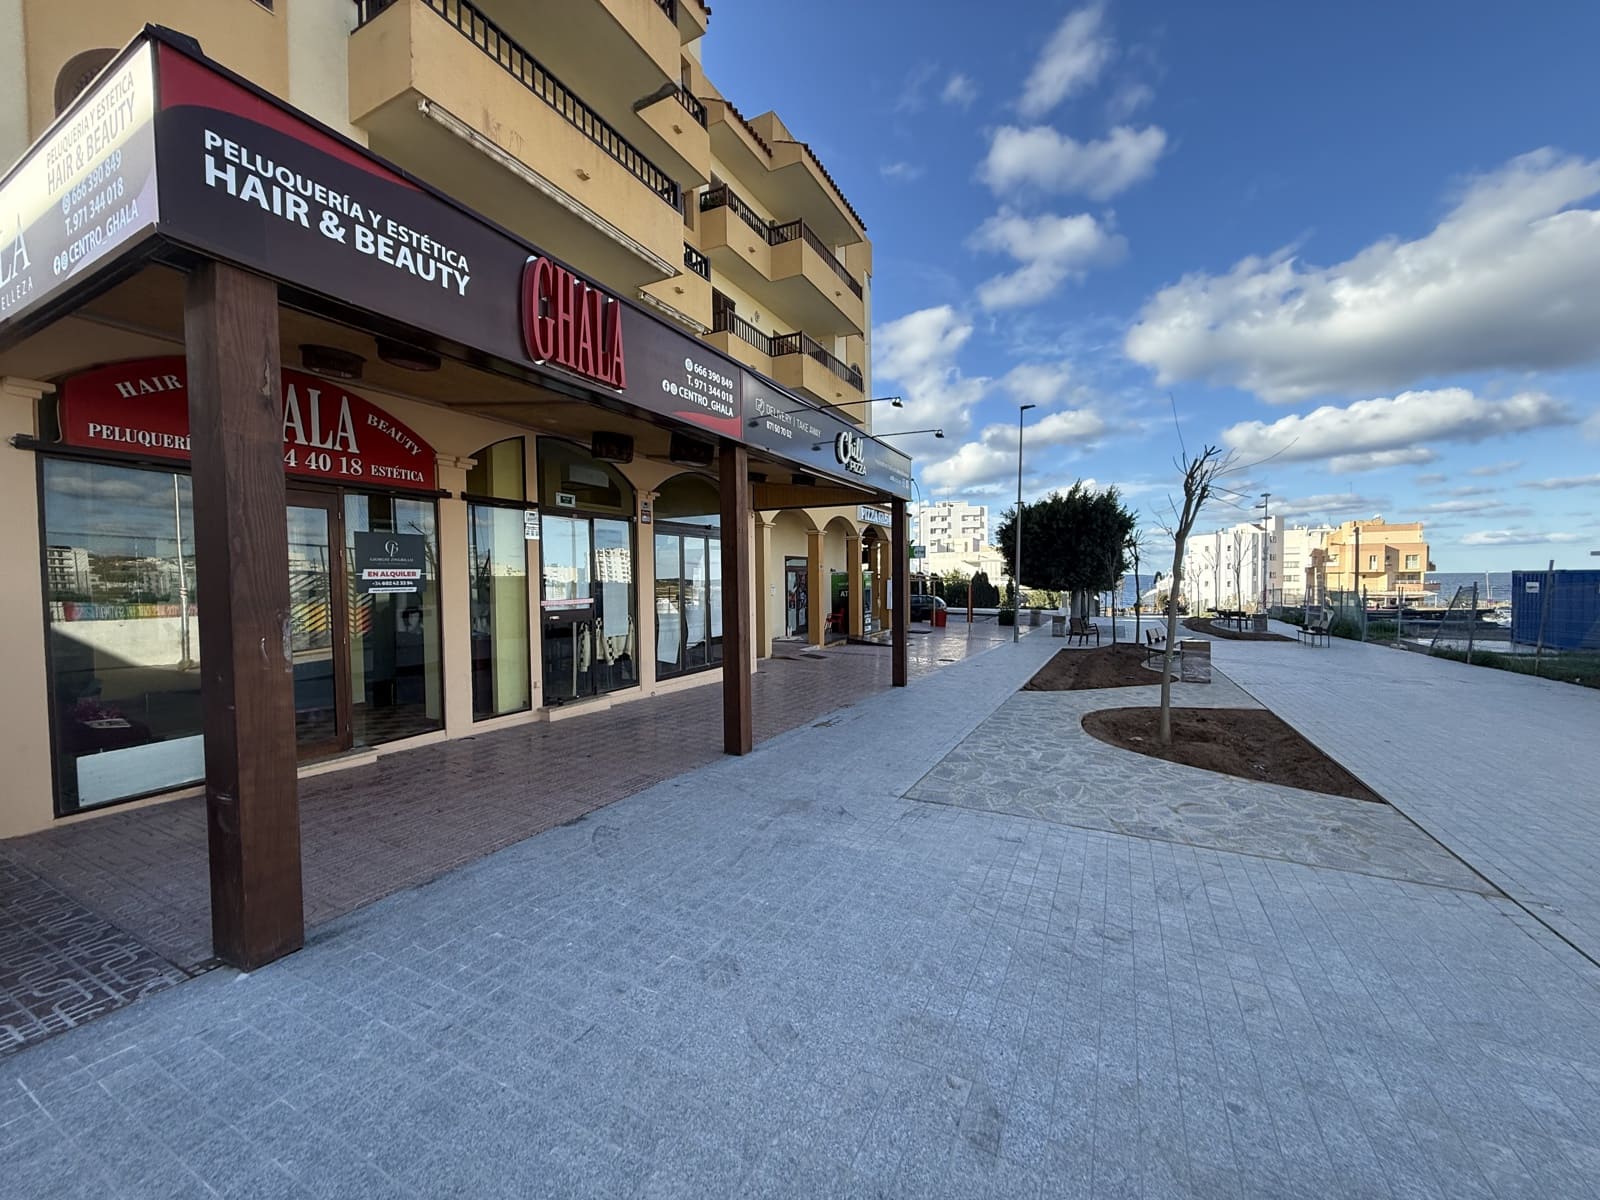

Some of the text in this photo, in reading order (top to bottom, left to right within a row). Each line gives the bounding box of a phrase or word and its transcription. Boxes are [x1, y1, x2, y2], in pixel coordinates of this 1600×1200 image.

[47, 91, 135, 196] HAIR & BEAUTY
[71, 149, 122, 206] 666 390 849
[89, 194, 106, 219] 344
[106, 177, 124, 208] 018
[204, 129, 470, 273] PELUQUERÍA Y ESTÉTICA
[69, 198, 139, 263] CENTRO_GHALA
[204, 153, 471, 297] HAIR & BEAUTY
[523, 256, 628, 390] GHALA
[114, 375, 183, 398] HAIR
[693, 363, 733, 389] 666 390 849
[708, 384, 720, 398] 344
[721, 391, 733, 404] 018
[282, 383, 360, 454] ALA
[678, 386, 734, 417] CENTRO_GHALA
[766, 403, 792, 425] DELIVERY
[796, 418, 809, 433] TAKE
[367, 413, 422, 456] BEAUTY
[838, 431, 865, 464] Chill
[304, 451, 331, 472] 40
[339, 456, 362, 476] 18
[371, 464, 424, 482] ESTÉTICA
[849, 460, 866, 476] PIZZA
